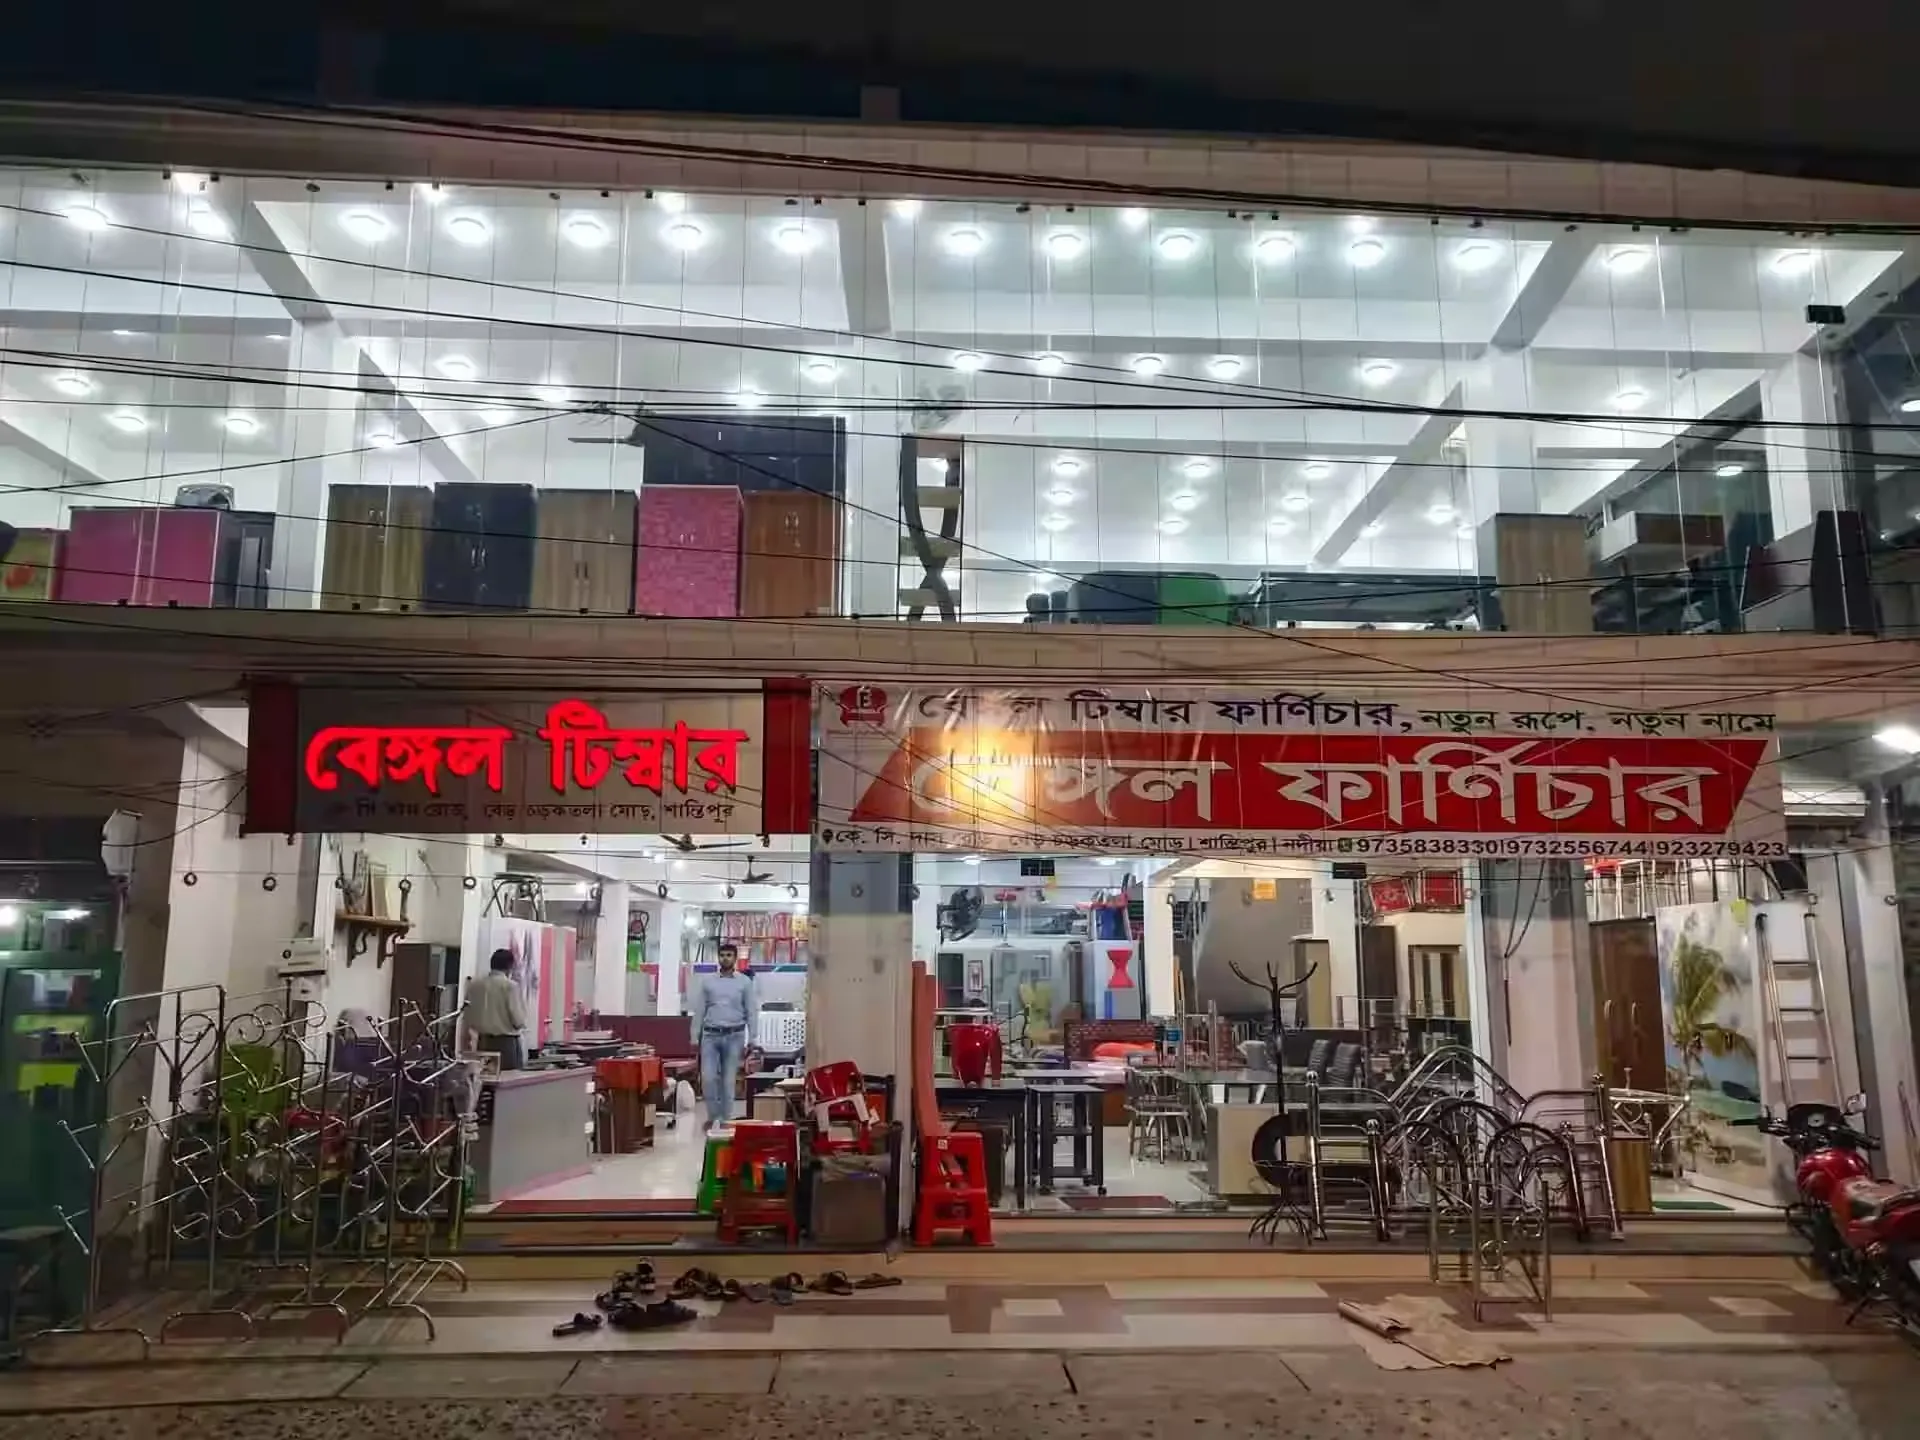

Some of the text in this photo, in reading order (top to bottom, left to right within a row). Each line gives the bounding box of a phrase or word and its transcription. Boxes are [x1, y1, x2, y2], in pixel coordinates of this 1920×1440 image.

[304, 698, 750, 796] বেঙ্গল টিম্বার
[1064, 688, 1198, 724] টিম্বার
[1417, 710, 1498, 735] নতুন
[1608, 711, 1689, 736] নতুন
[1697, 712, 1776, 735] নামে
